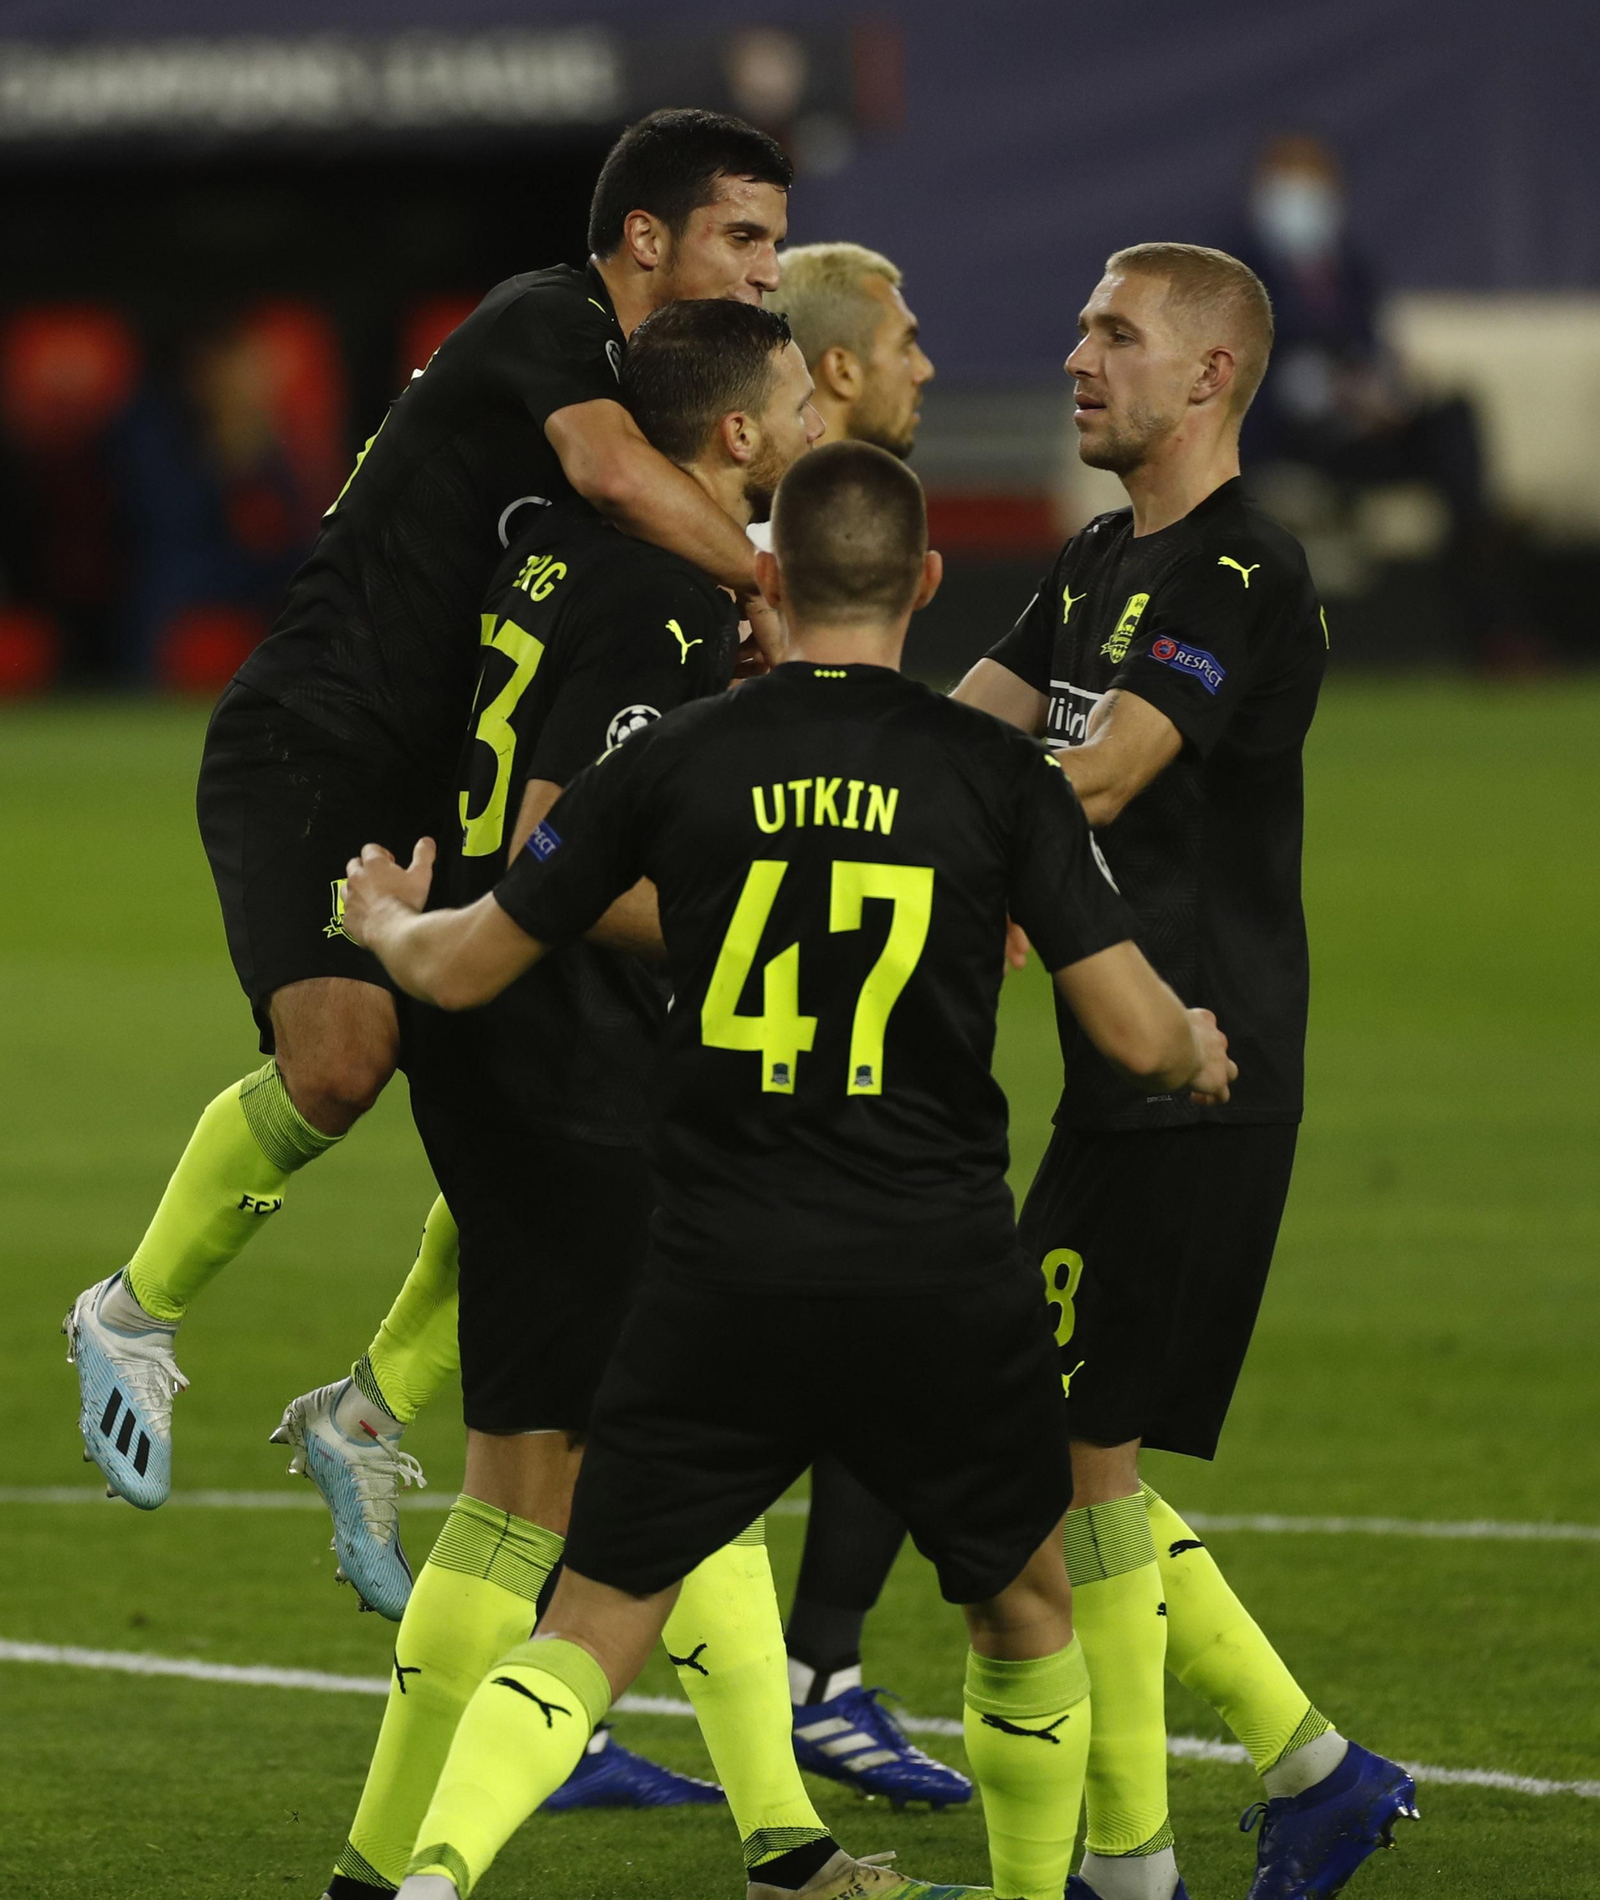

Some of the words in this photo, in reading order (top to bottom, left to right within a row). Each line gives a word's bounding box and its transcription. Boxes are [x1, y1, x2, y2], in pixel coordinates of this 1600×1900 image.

[1174, 650, 1223, 687] RESPECT
[458, 612, 545, 857] 3
[752, 776, 899, 835] UTKIN
[701, 860, 935, 1096] 47
[1041, 1248, 1084, 1347] 8
